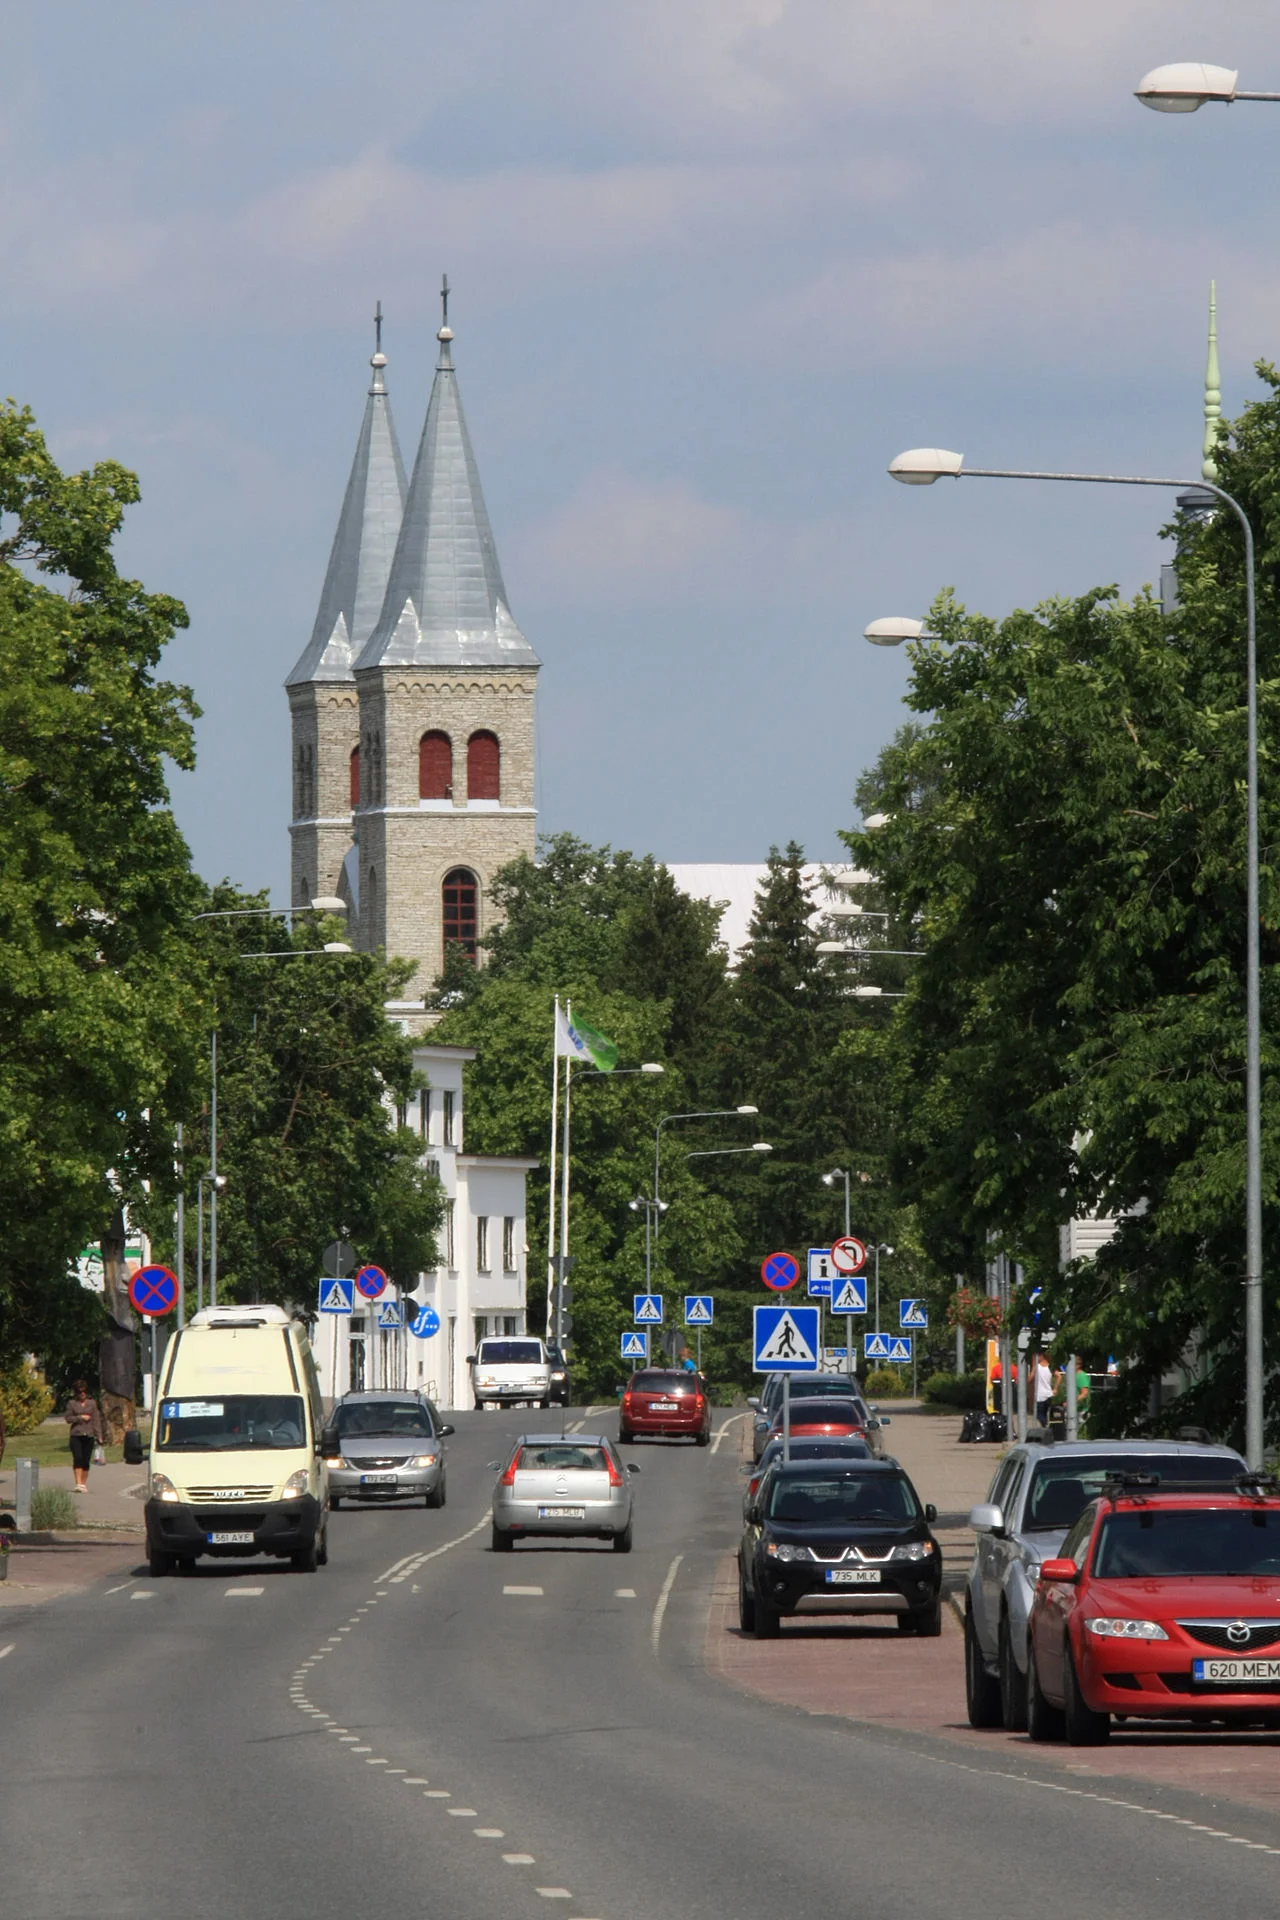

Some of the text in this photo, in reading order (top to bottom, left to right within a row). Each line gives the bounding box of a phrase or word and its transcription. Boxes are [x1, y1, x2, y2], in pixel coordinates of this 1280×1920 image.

[168, 1406, 176, 1417] 2
[215, 1533, 251, 1543] 561 AYE
[835, 1571, 877, 1581] 735 MLK
[1209, 1663, 1238, 1678] 620
[1243, 1663, 1280, 1677] MEM
